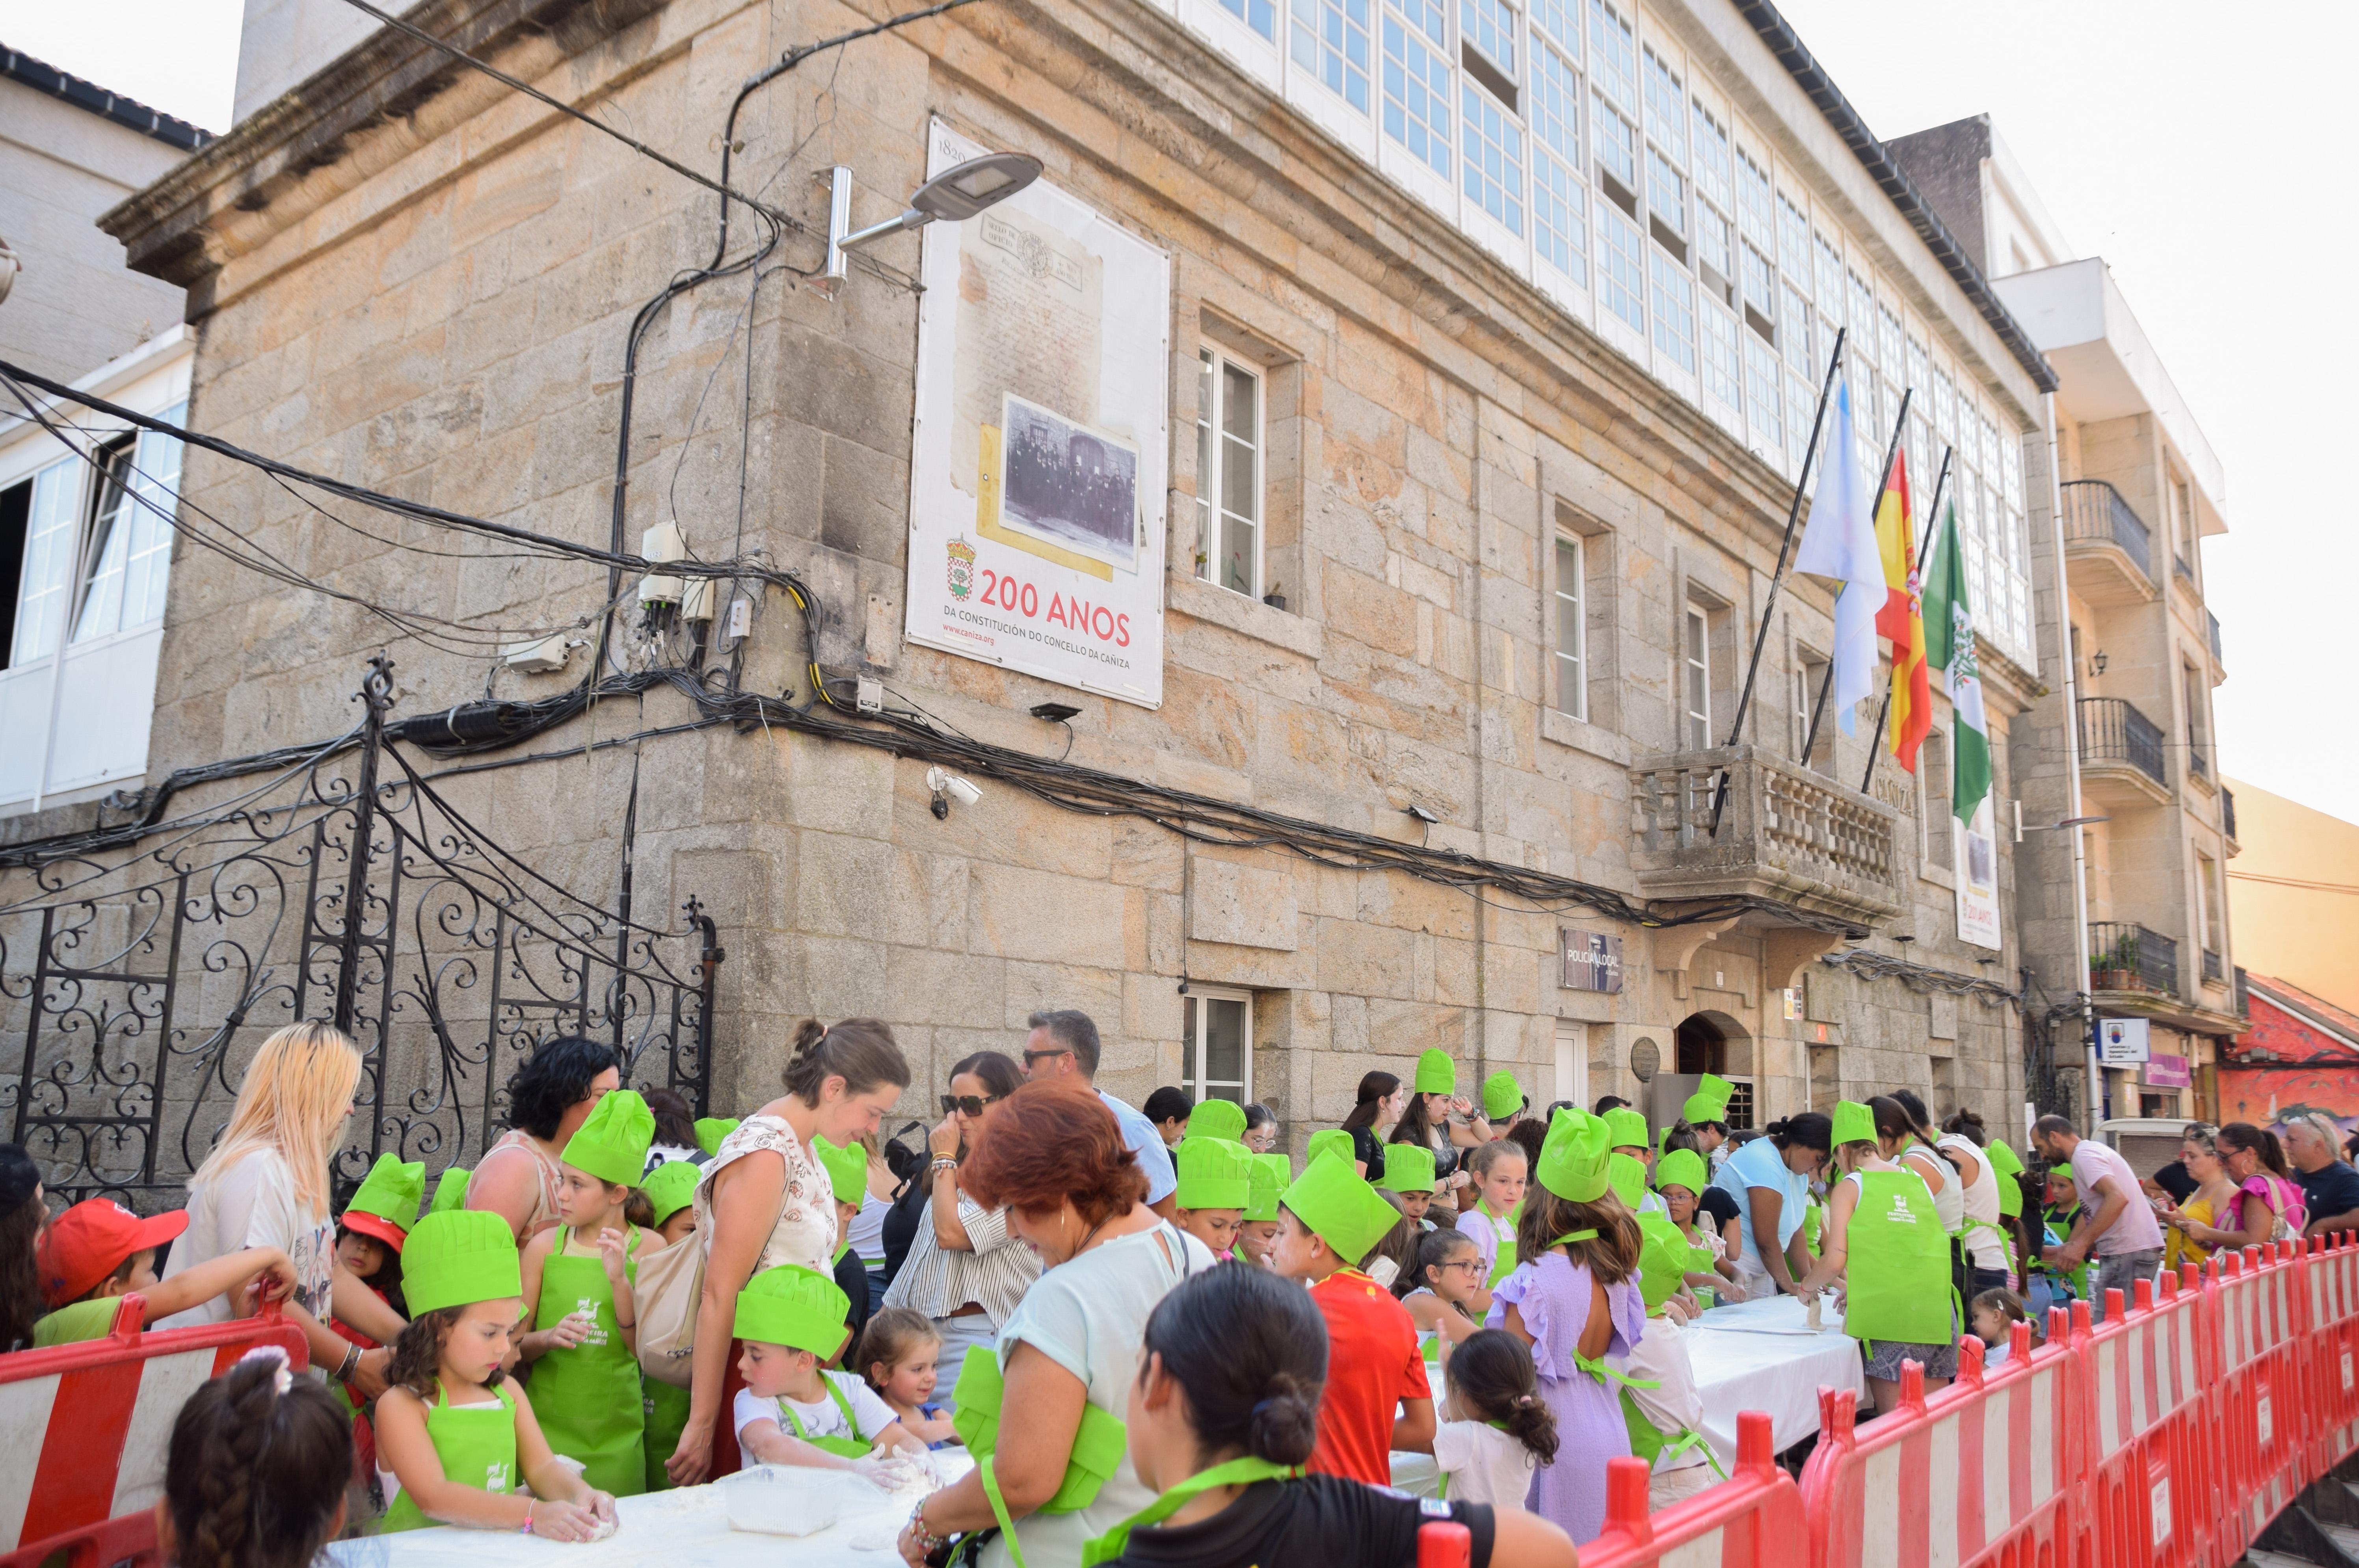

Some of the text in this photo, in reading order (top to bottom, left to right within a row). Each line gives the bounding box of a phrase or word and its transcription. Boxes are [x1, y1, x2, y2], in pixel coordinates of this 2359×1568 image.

[939, 139, 966, 164] 1820
[988, 221, 1016, 240] SELLO DE
[989, 232, 1012, 247] OFICIO
[980, 569, 1130, 647] 200 ANOS
[943, 624, 995, 646] www.caniza.org
[944, 605, 1130, 670] DA CONSTITUCIÓN DO CONCELLO DA CAÑIZA
[1568, 949, 1619, 967] POLICÍA LOCAL
